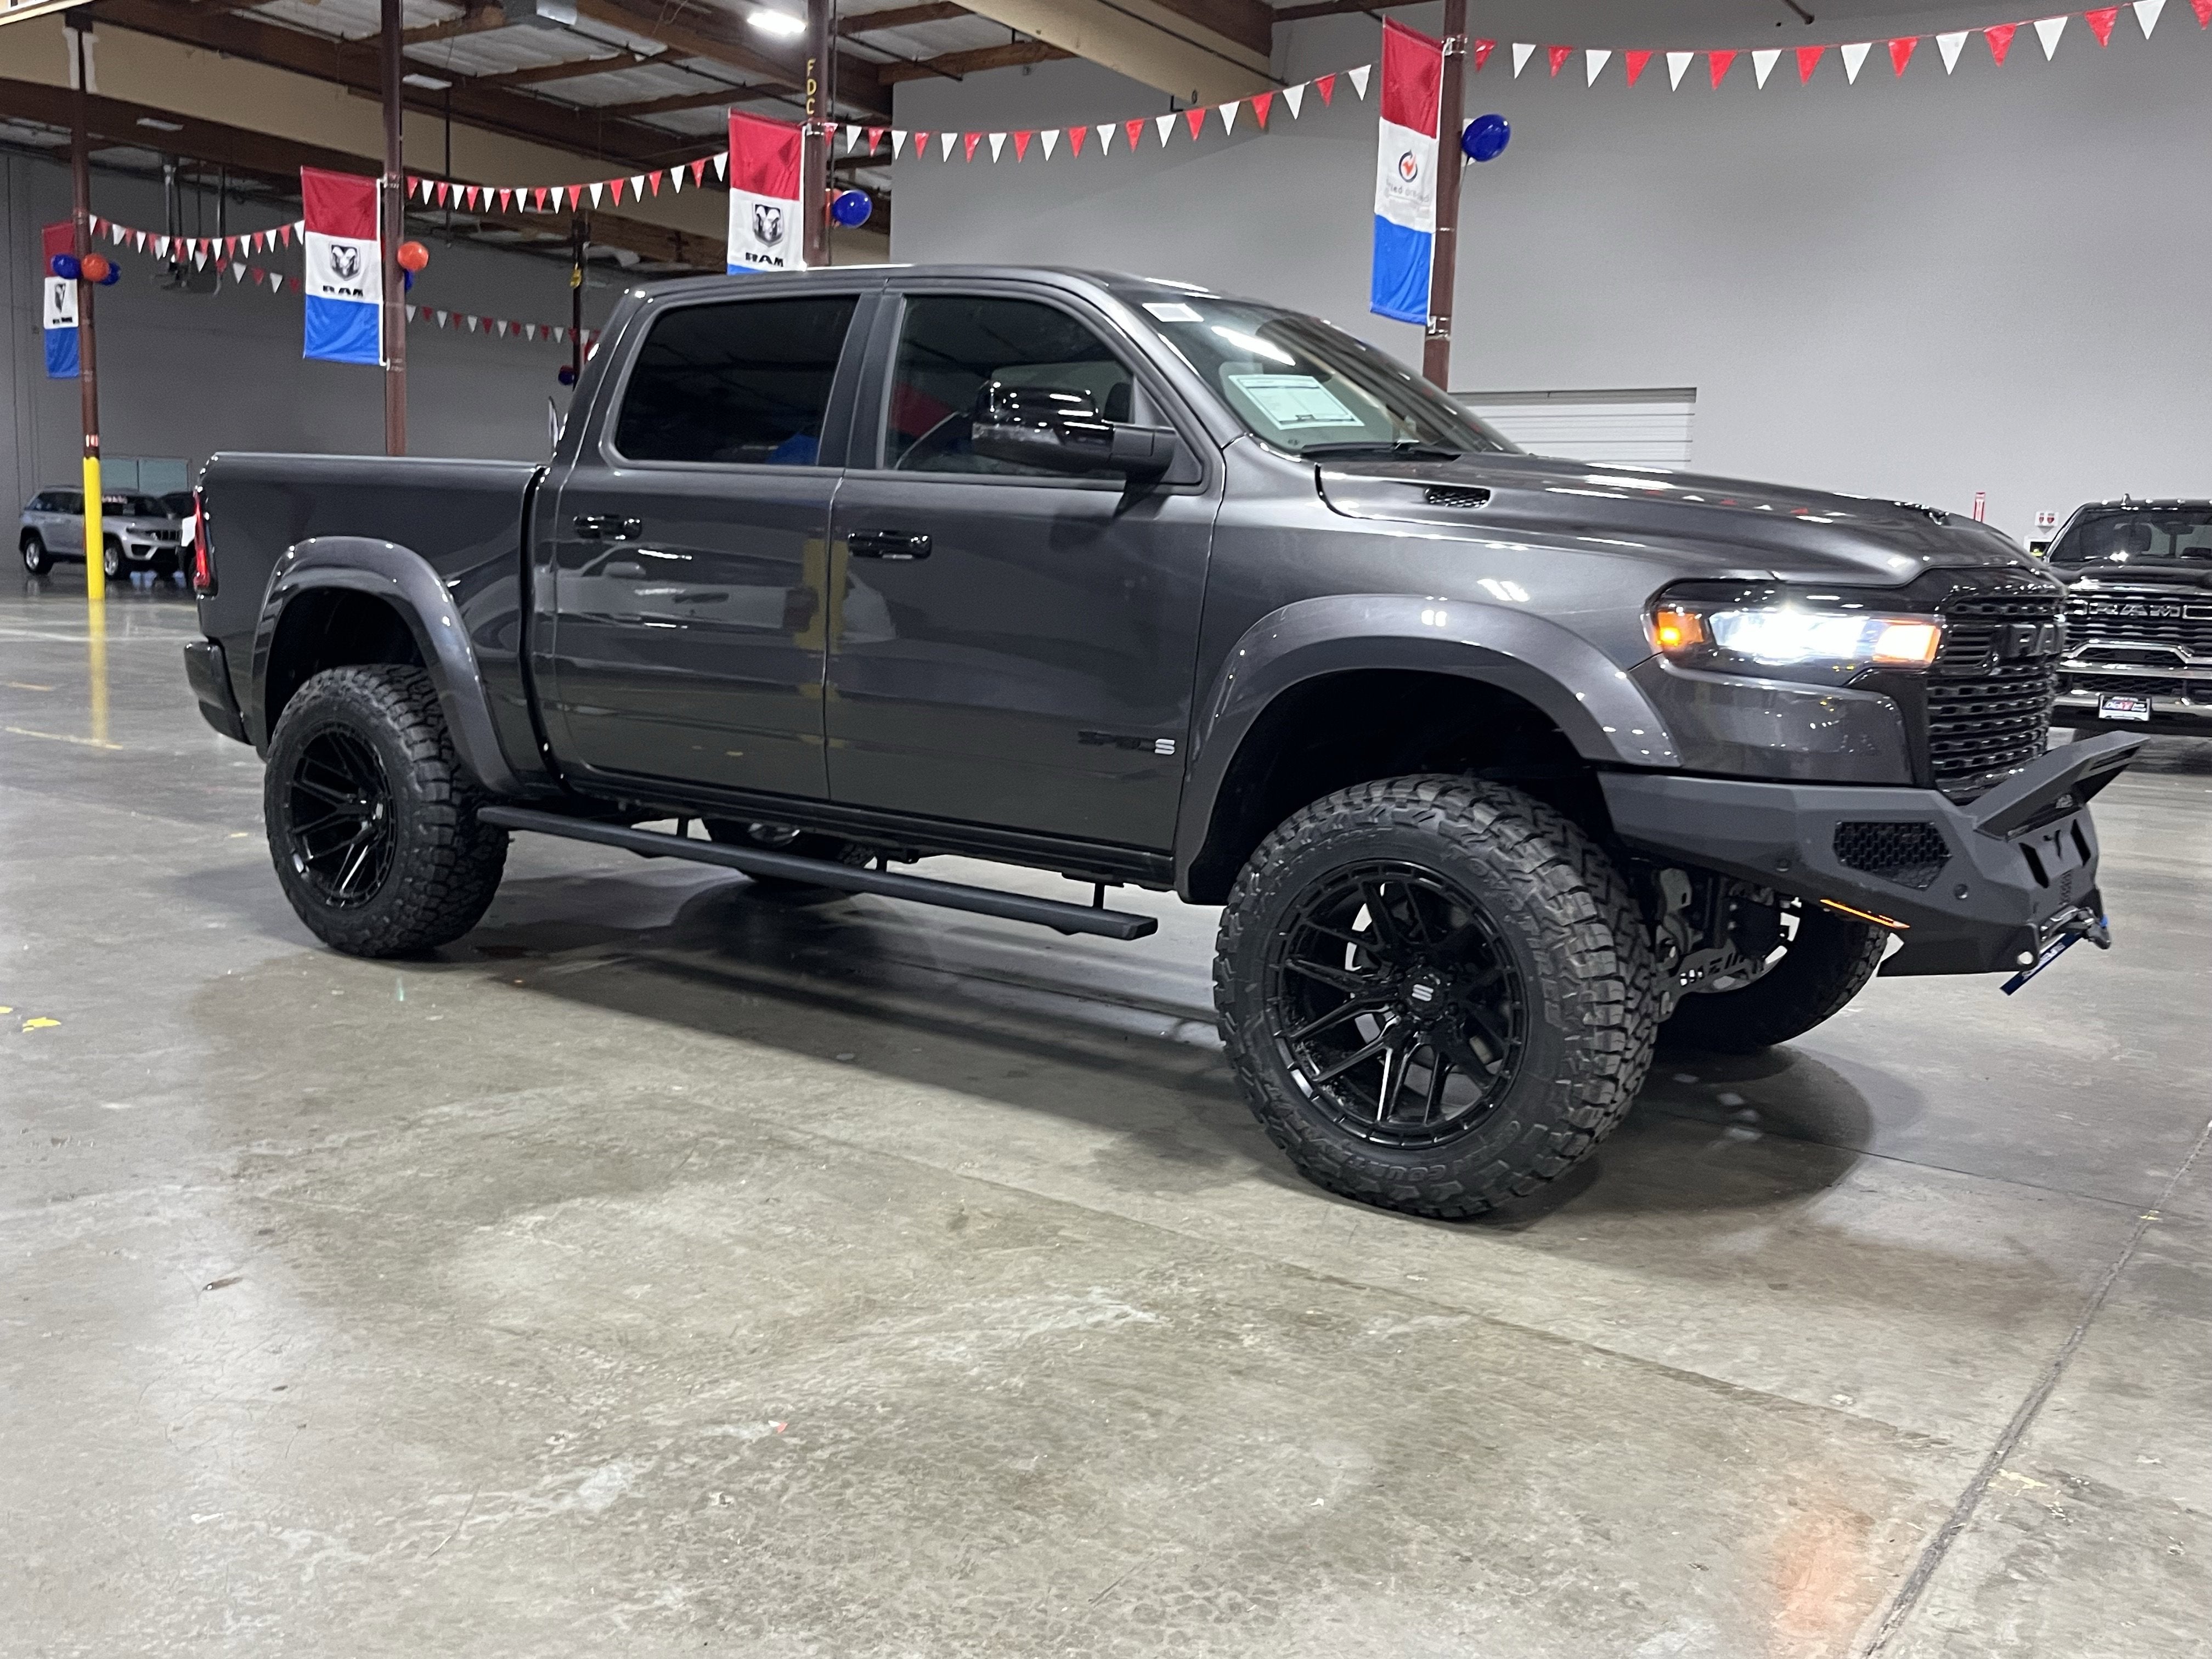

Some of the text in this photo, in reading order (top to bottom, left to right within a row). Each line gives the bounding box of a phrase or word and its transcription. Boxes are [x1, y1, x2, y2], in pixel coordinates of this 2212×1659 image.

[806, 58, 817, 115] FDC
[745, 252, 783, 267] RAM
[2089, 602, 2181, 617] RAM
